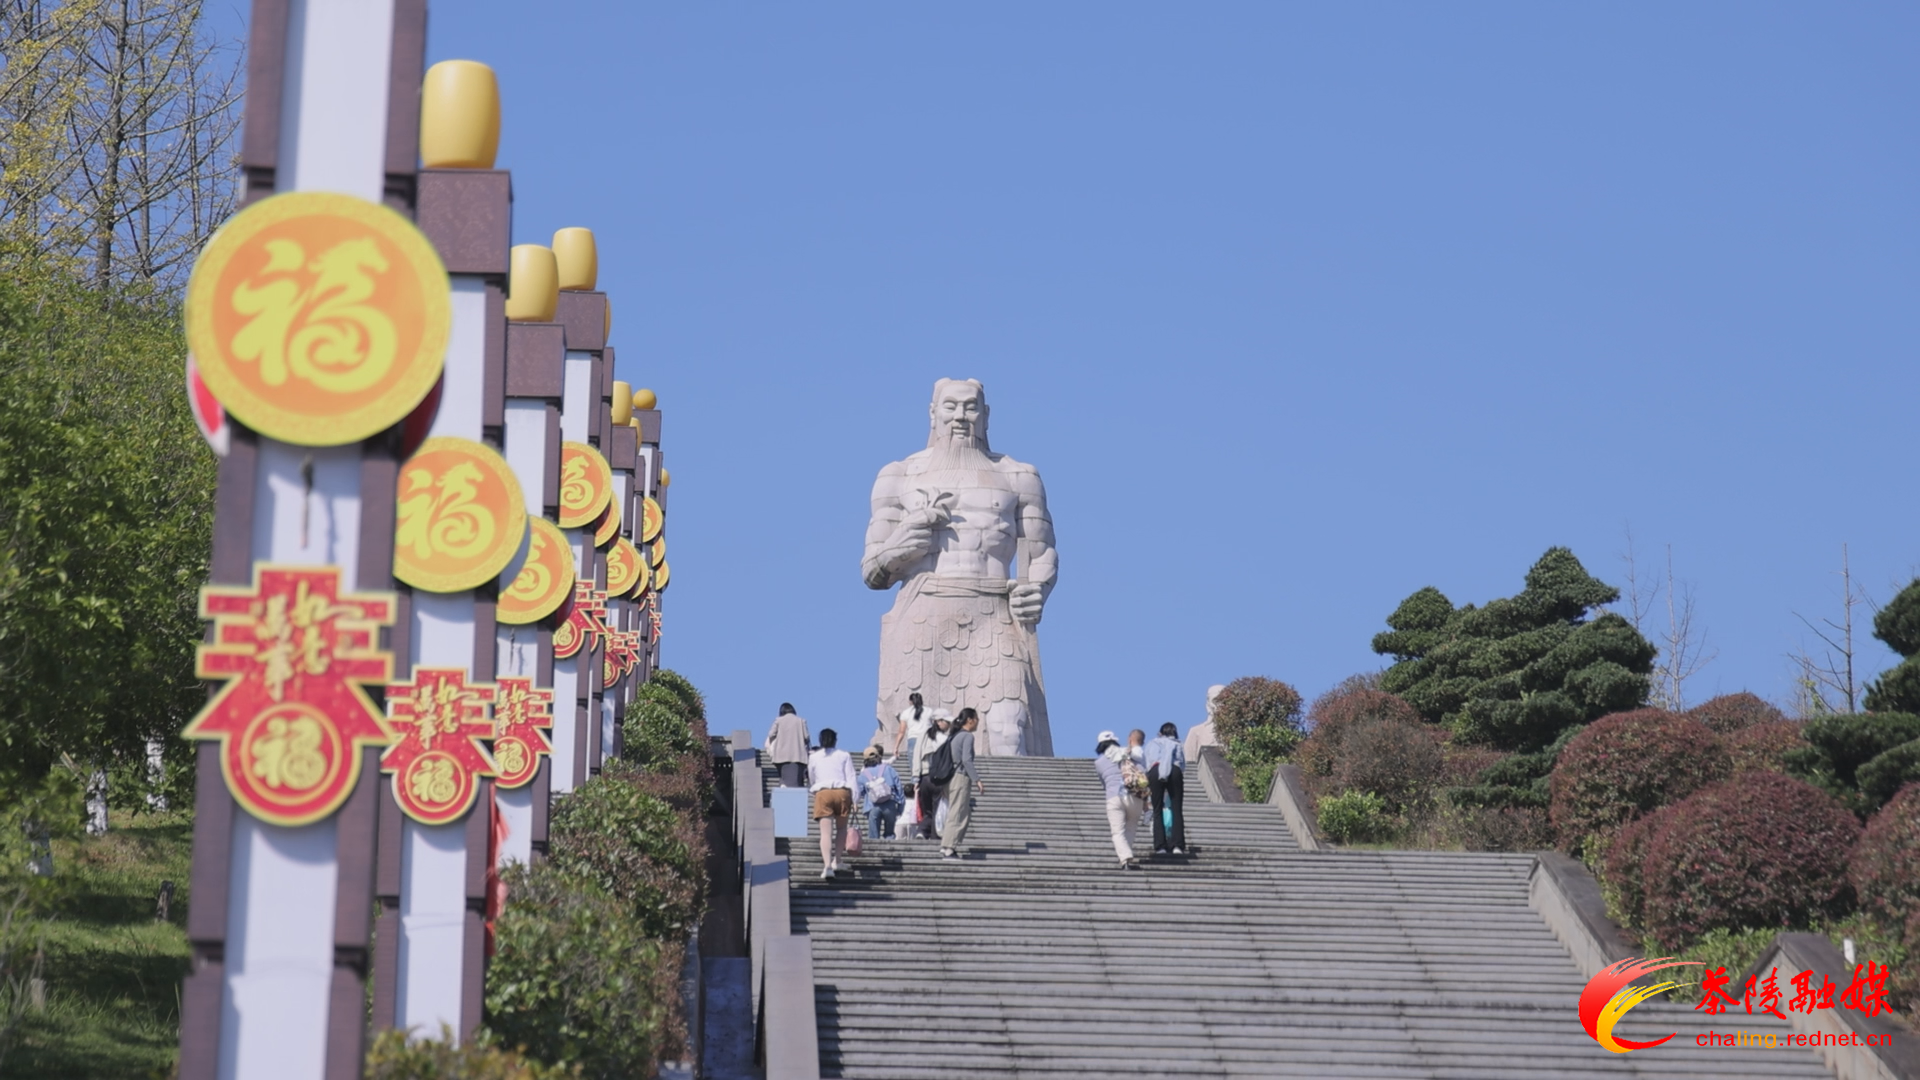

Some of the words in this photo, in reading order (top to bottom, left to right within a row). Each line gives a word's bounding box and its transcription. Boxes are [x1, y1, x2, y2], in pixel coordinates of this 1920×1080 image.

[231, 236, 397, 394] 福
[252, 715, 328, 790] 福
[411, 759, 457, 803] 福
